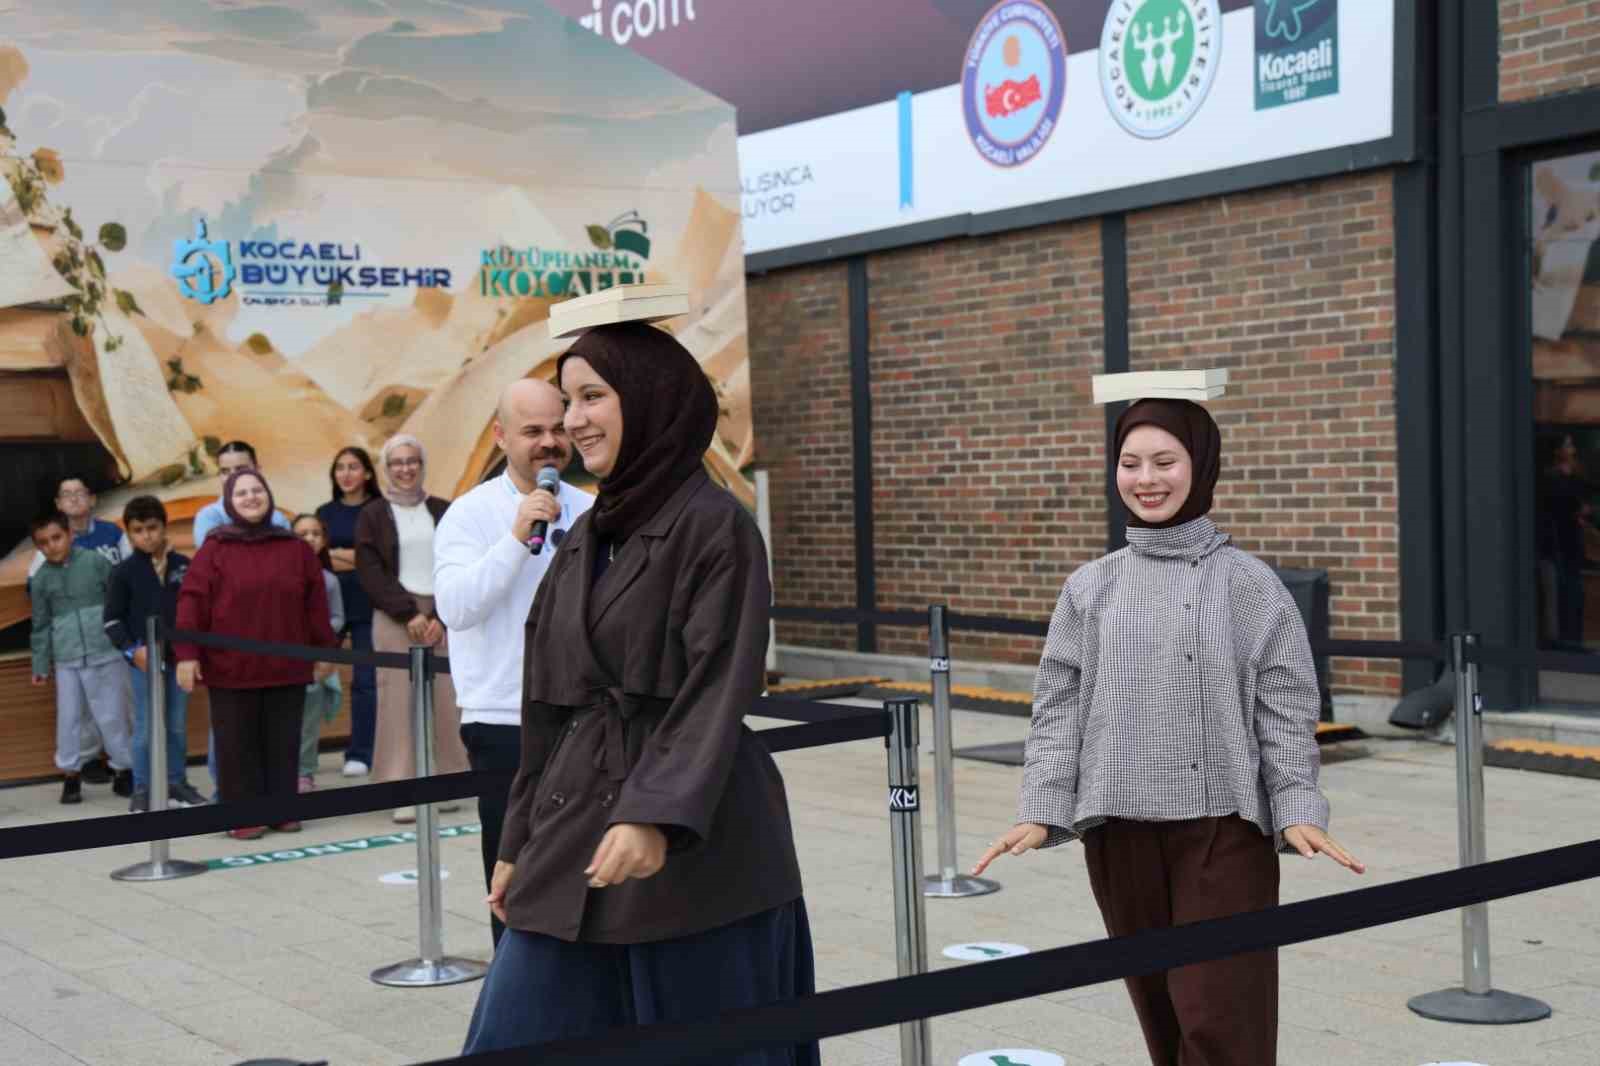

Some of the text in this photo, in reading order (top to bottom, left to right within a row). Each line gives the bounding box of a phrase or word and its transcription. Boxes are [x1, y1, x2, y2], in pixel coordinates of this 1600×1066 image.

[1259, 38, 1332, 81] Kocaeli
[240, 240, 360, 261] KOCAELİ
[480, 244, 629, 271] KÜTÜPHANEM
[241, 263, 451, 288] BÜYÜKŞEHİR
